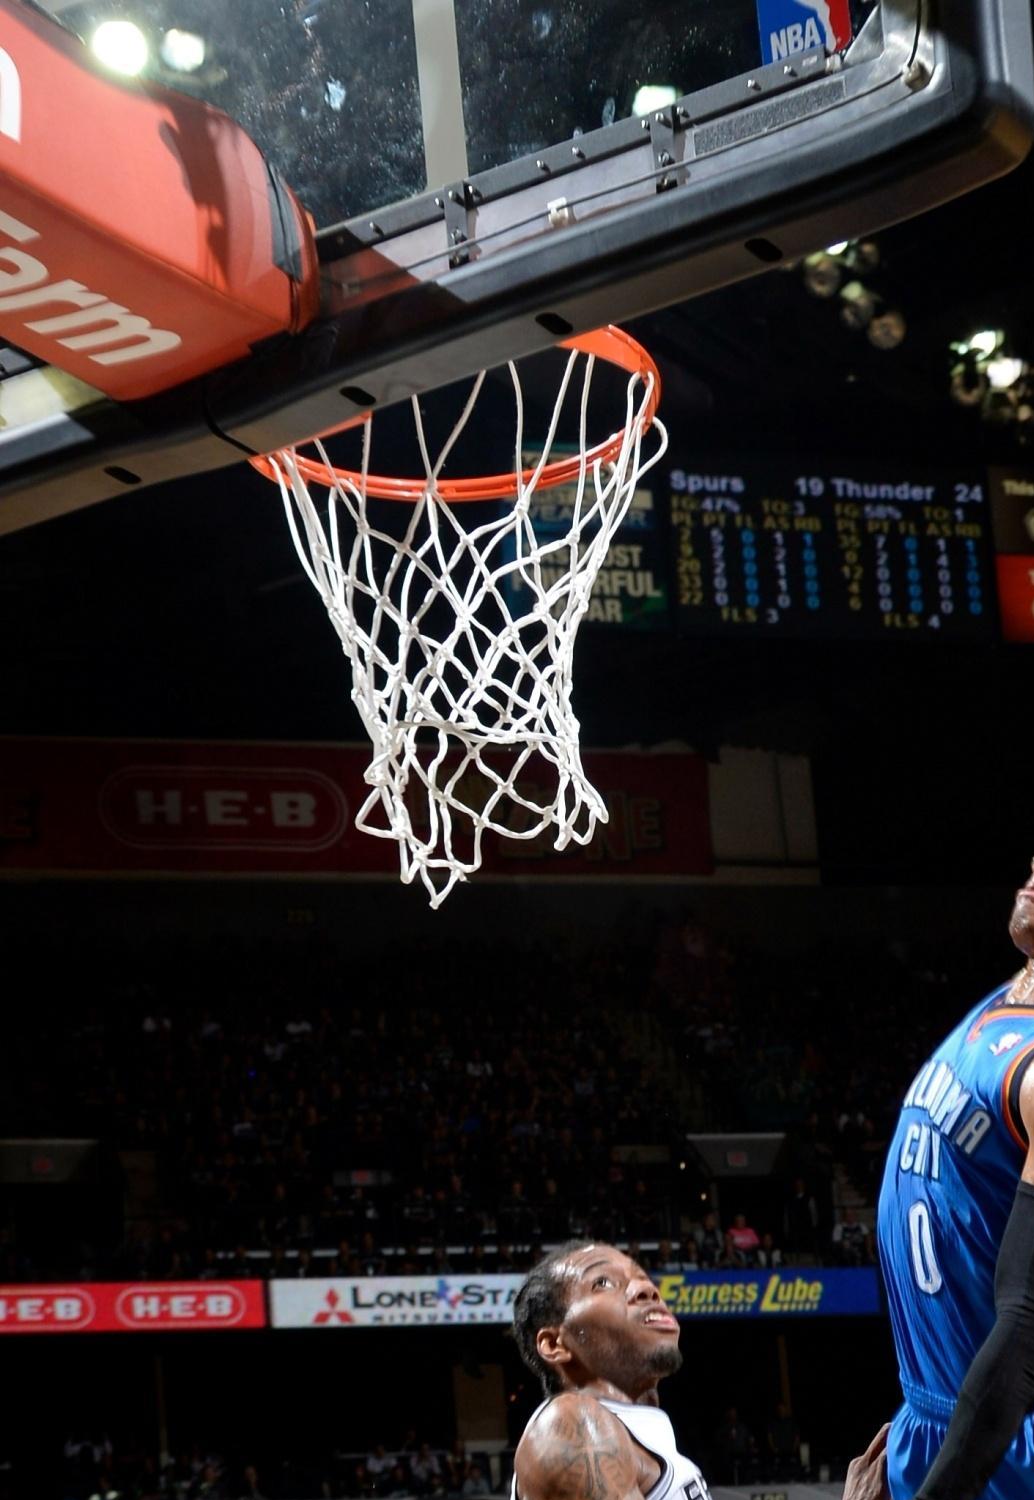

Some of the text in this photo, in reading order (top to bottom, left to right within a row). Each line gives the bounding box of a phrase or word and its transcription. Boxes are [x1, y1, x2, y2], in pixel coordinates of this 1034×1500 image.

[770, 18, 822, 63] NBA
[669, 468, 825, 497] Spurs 19
[830, 477, 984, 503] Thunder 24
[512, 568, 664, 599] RFUL
[908, 1200, 943, 1295] 0
[463, 1284, 518, 1305] ST
